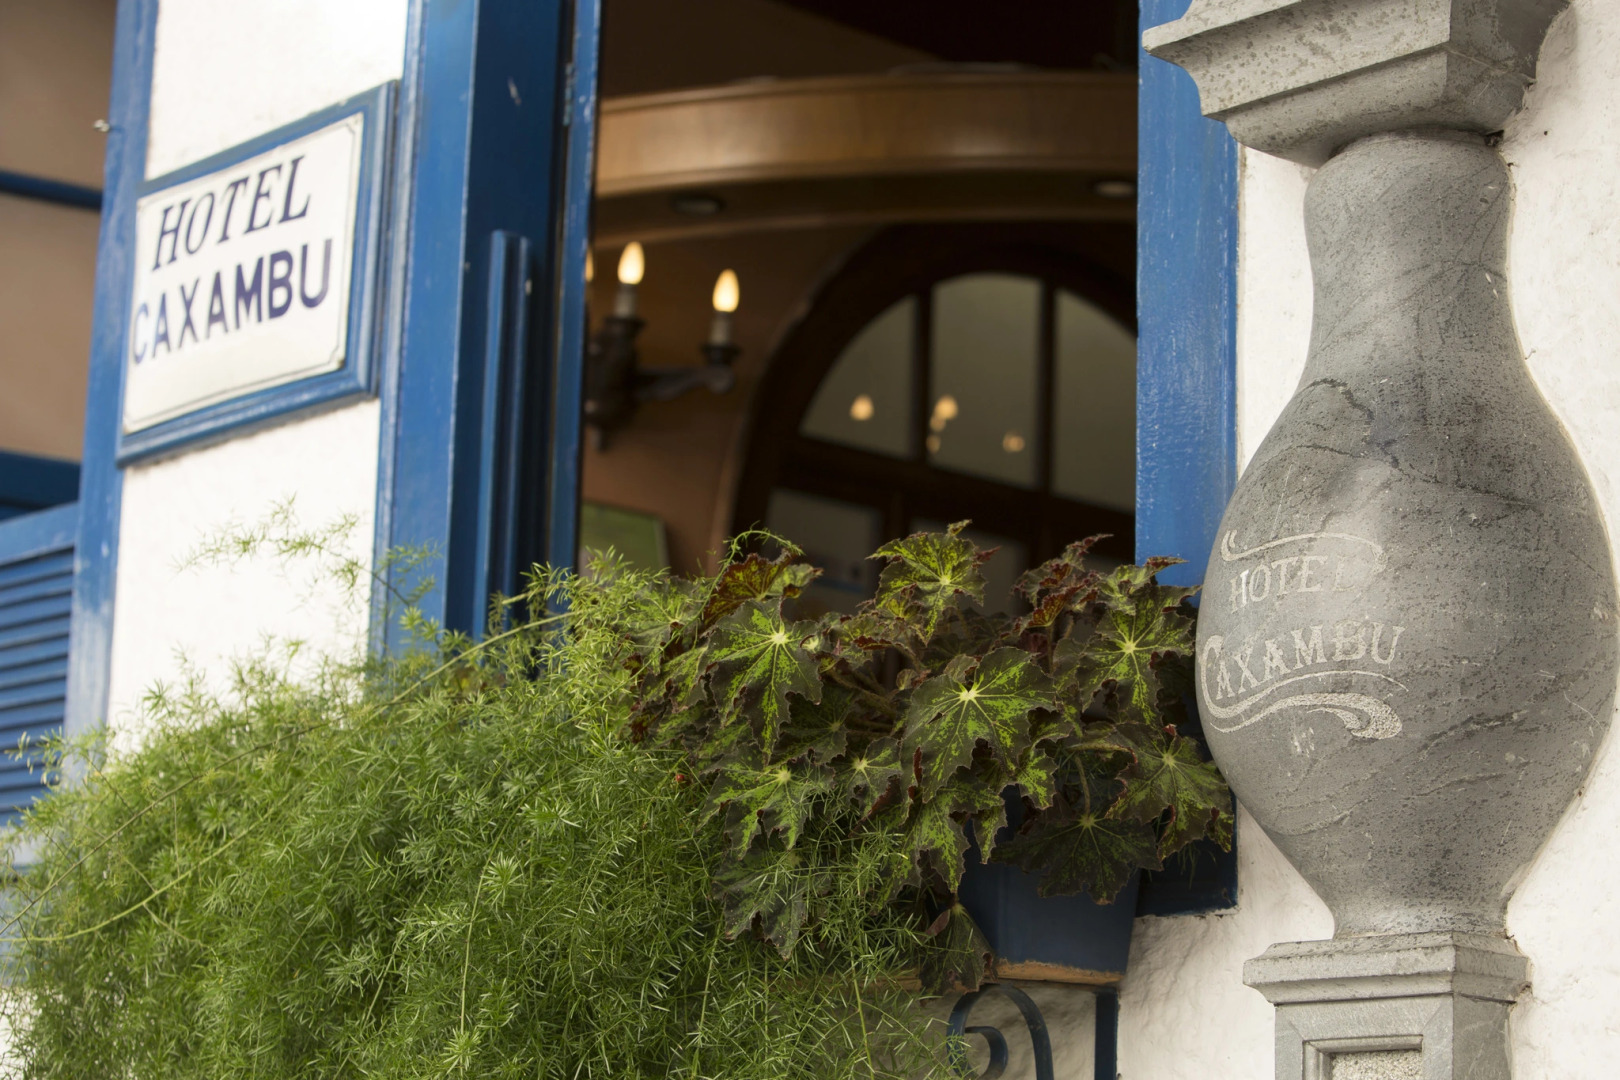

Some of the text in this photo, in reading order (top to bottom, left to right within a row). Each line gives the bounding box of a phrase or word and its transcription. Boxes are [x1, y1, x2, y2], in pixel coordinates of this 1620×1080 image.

[151, 155, 311, 271] HOTEL
[133, 238, 333, 365] CAXAMBU
[1229, 554, 1356, 614] HOTEL
[1201, 620, 1406, 706] CAXAMBU
